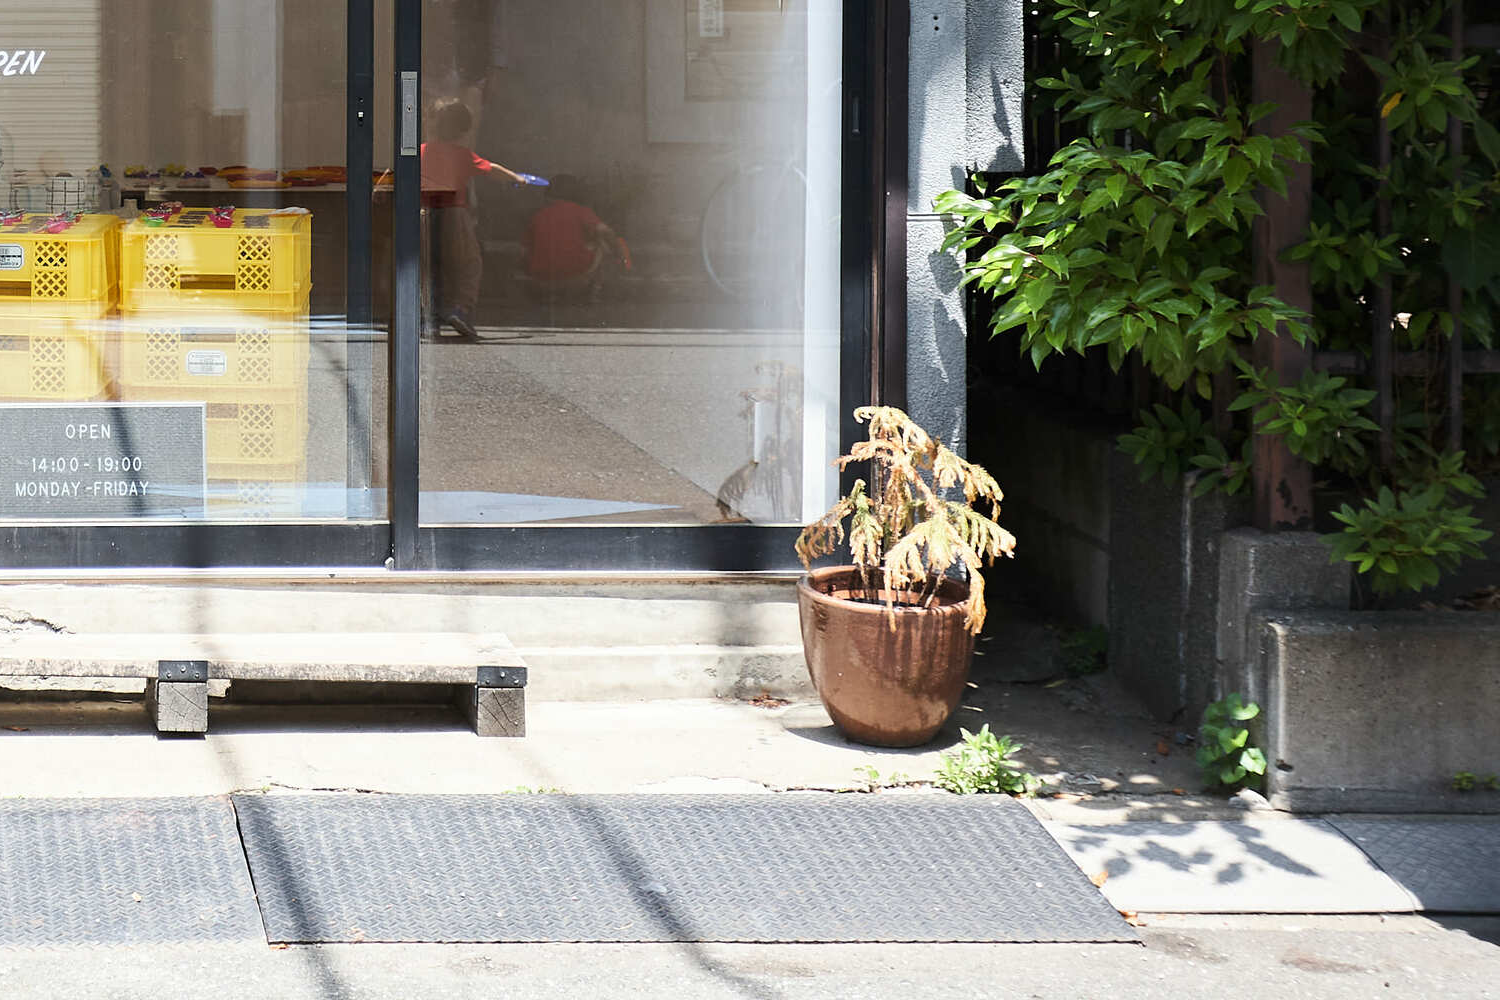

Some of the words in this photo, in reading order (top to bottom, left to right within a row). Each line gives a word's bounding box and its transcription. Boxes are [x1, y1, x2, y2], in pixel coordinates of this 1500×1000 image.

[65, 424, 111, 439] OPEN
[32, 457, 79, 473] 14:00
[97, 456, 142, 472] 19:00
[15, 481, 80, 497] MONDAY
